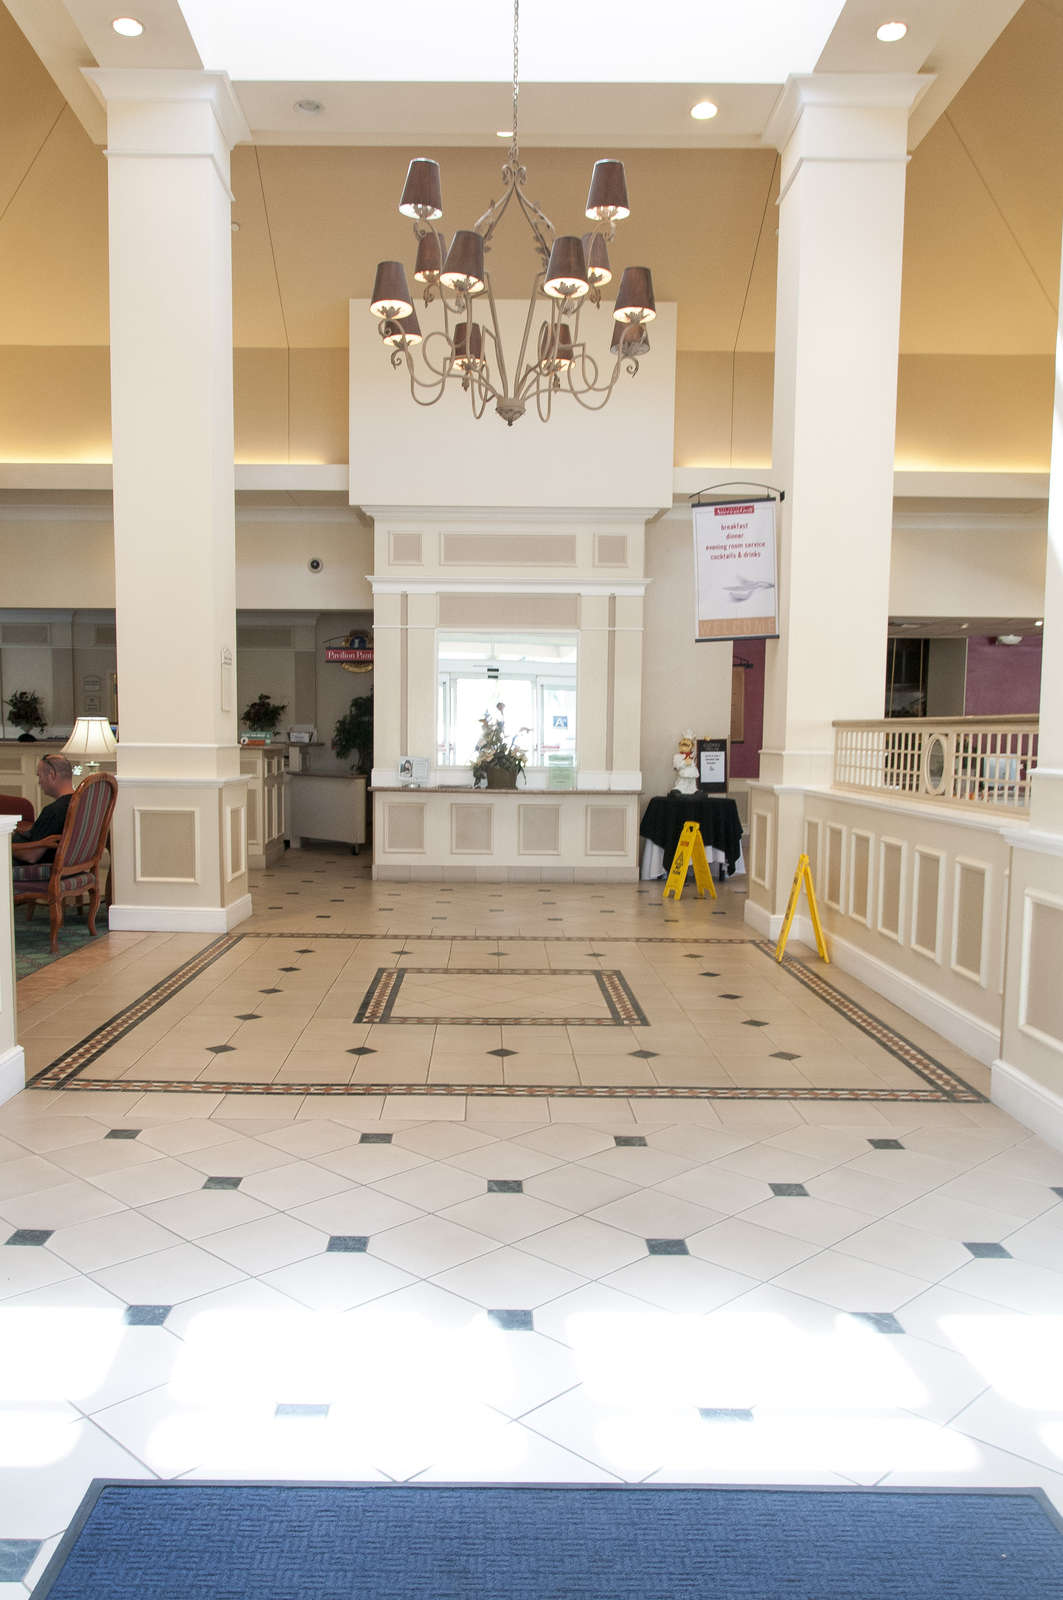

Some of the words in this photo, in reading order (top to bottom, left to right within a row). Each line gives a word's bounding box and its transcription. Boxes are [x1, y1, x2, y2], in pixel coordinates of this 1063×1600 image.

[720, 523, 749, 531] breakfast
[726, 533, 744, 541] dinner
[328, 650, 356, 659] Pavilion
